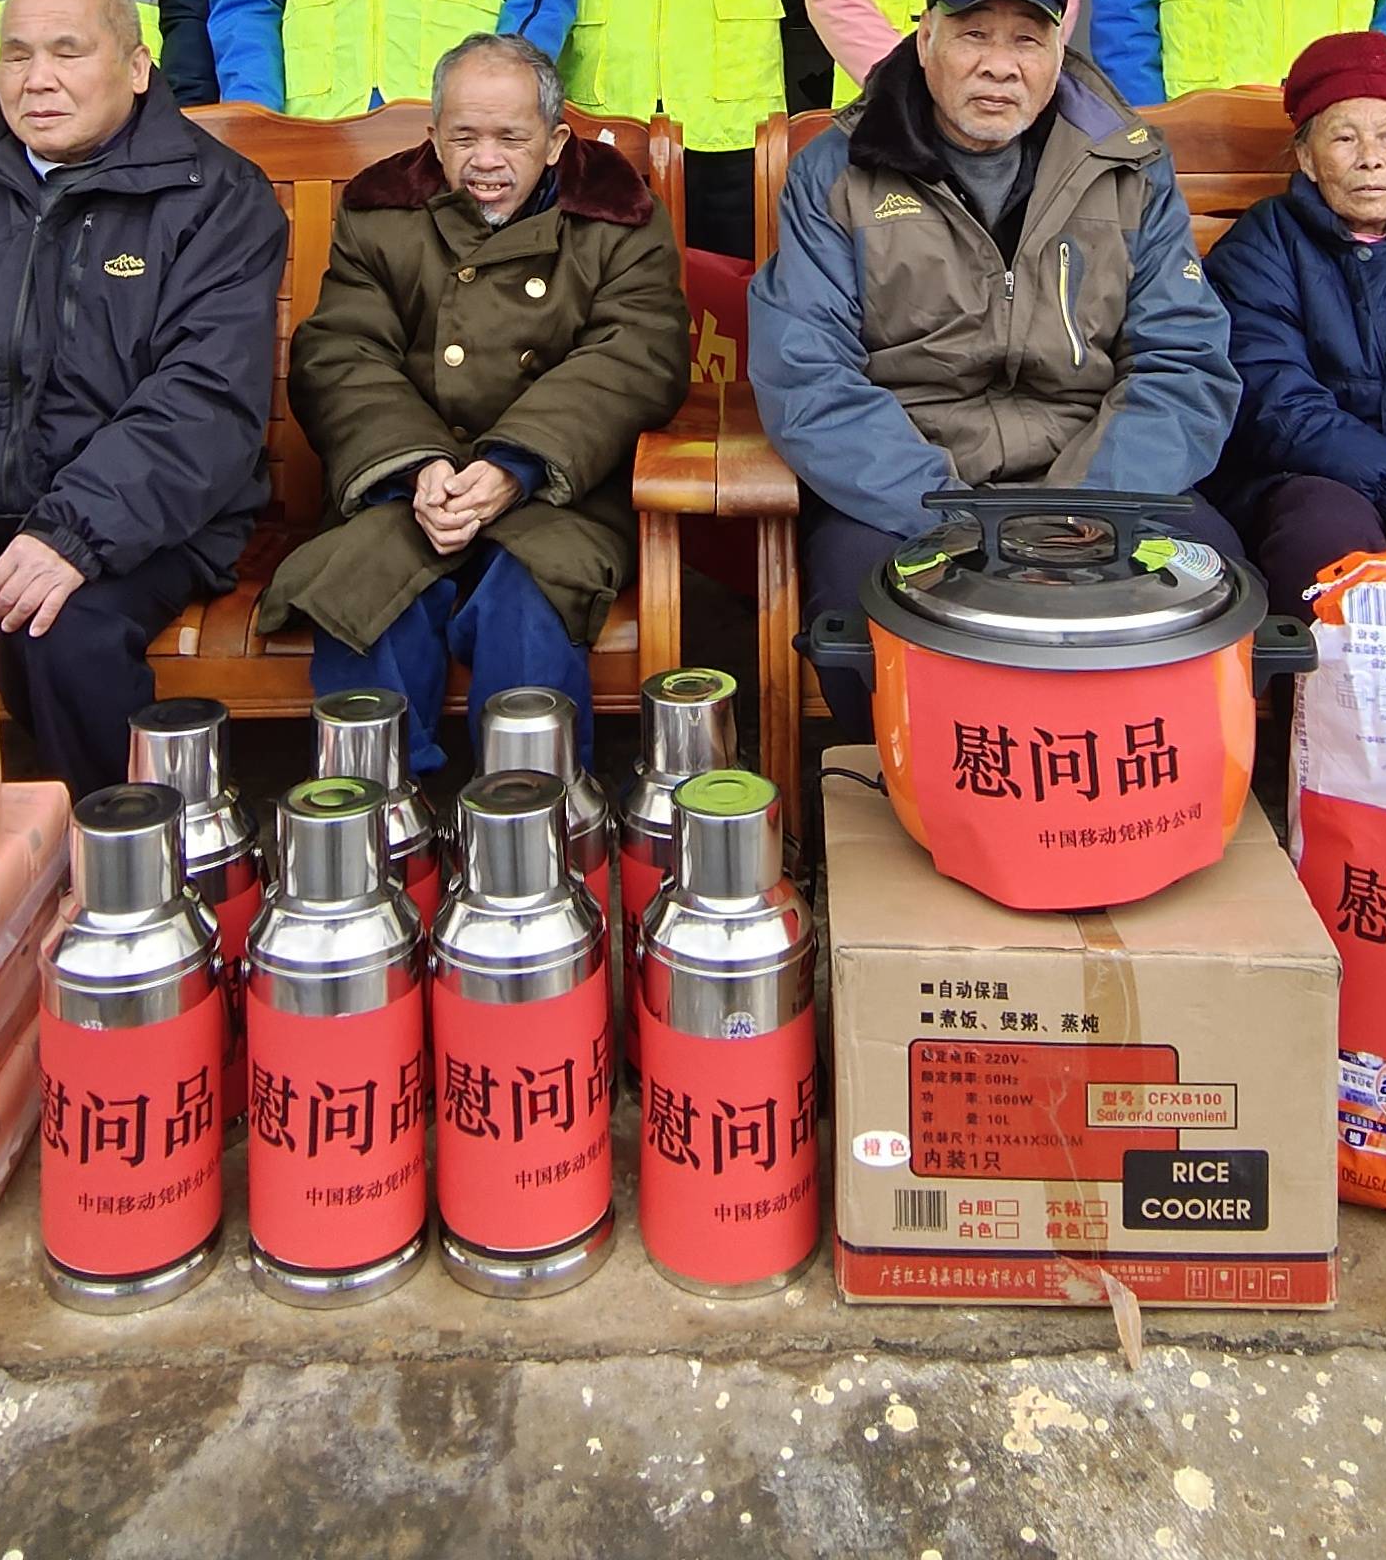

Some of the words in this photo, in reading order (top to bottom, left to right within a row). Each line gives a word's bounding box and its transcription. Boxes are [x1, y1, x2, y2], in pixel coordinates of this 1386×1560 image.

[951, 717, 1180, 802] 慰问品
[1038, 802, 1203, 849] 中国移动凭祥分公司
[939, 979, 1010, 1000] 自动保温
[251, 1050, 425, 1158] 慰问品
[1148, 1092, 1222, 1106] CFXB100
[40, 1065, 214, 1168] 慰问品
[1157, 1109, 1227, 1123] convenient
[924, 1149, 1002, 1172] 内装1只
[1172, 1161, 1230, 1183] RICE
[1141, 1197, 1251, 1220] COOKER
